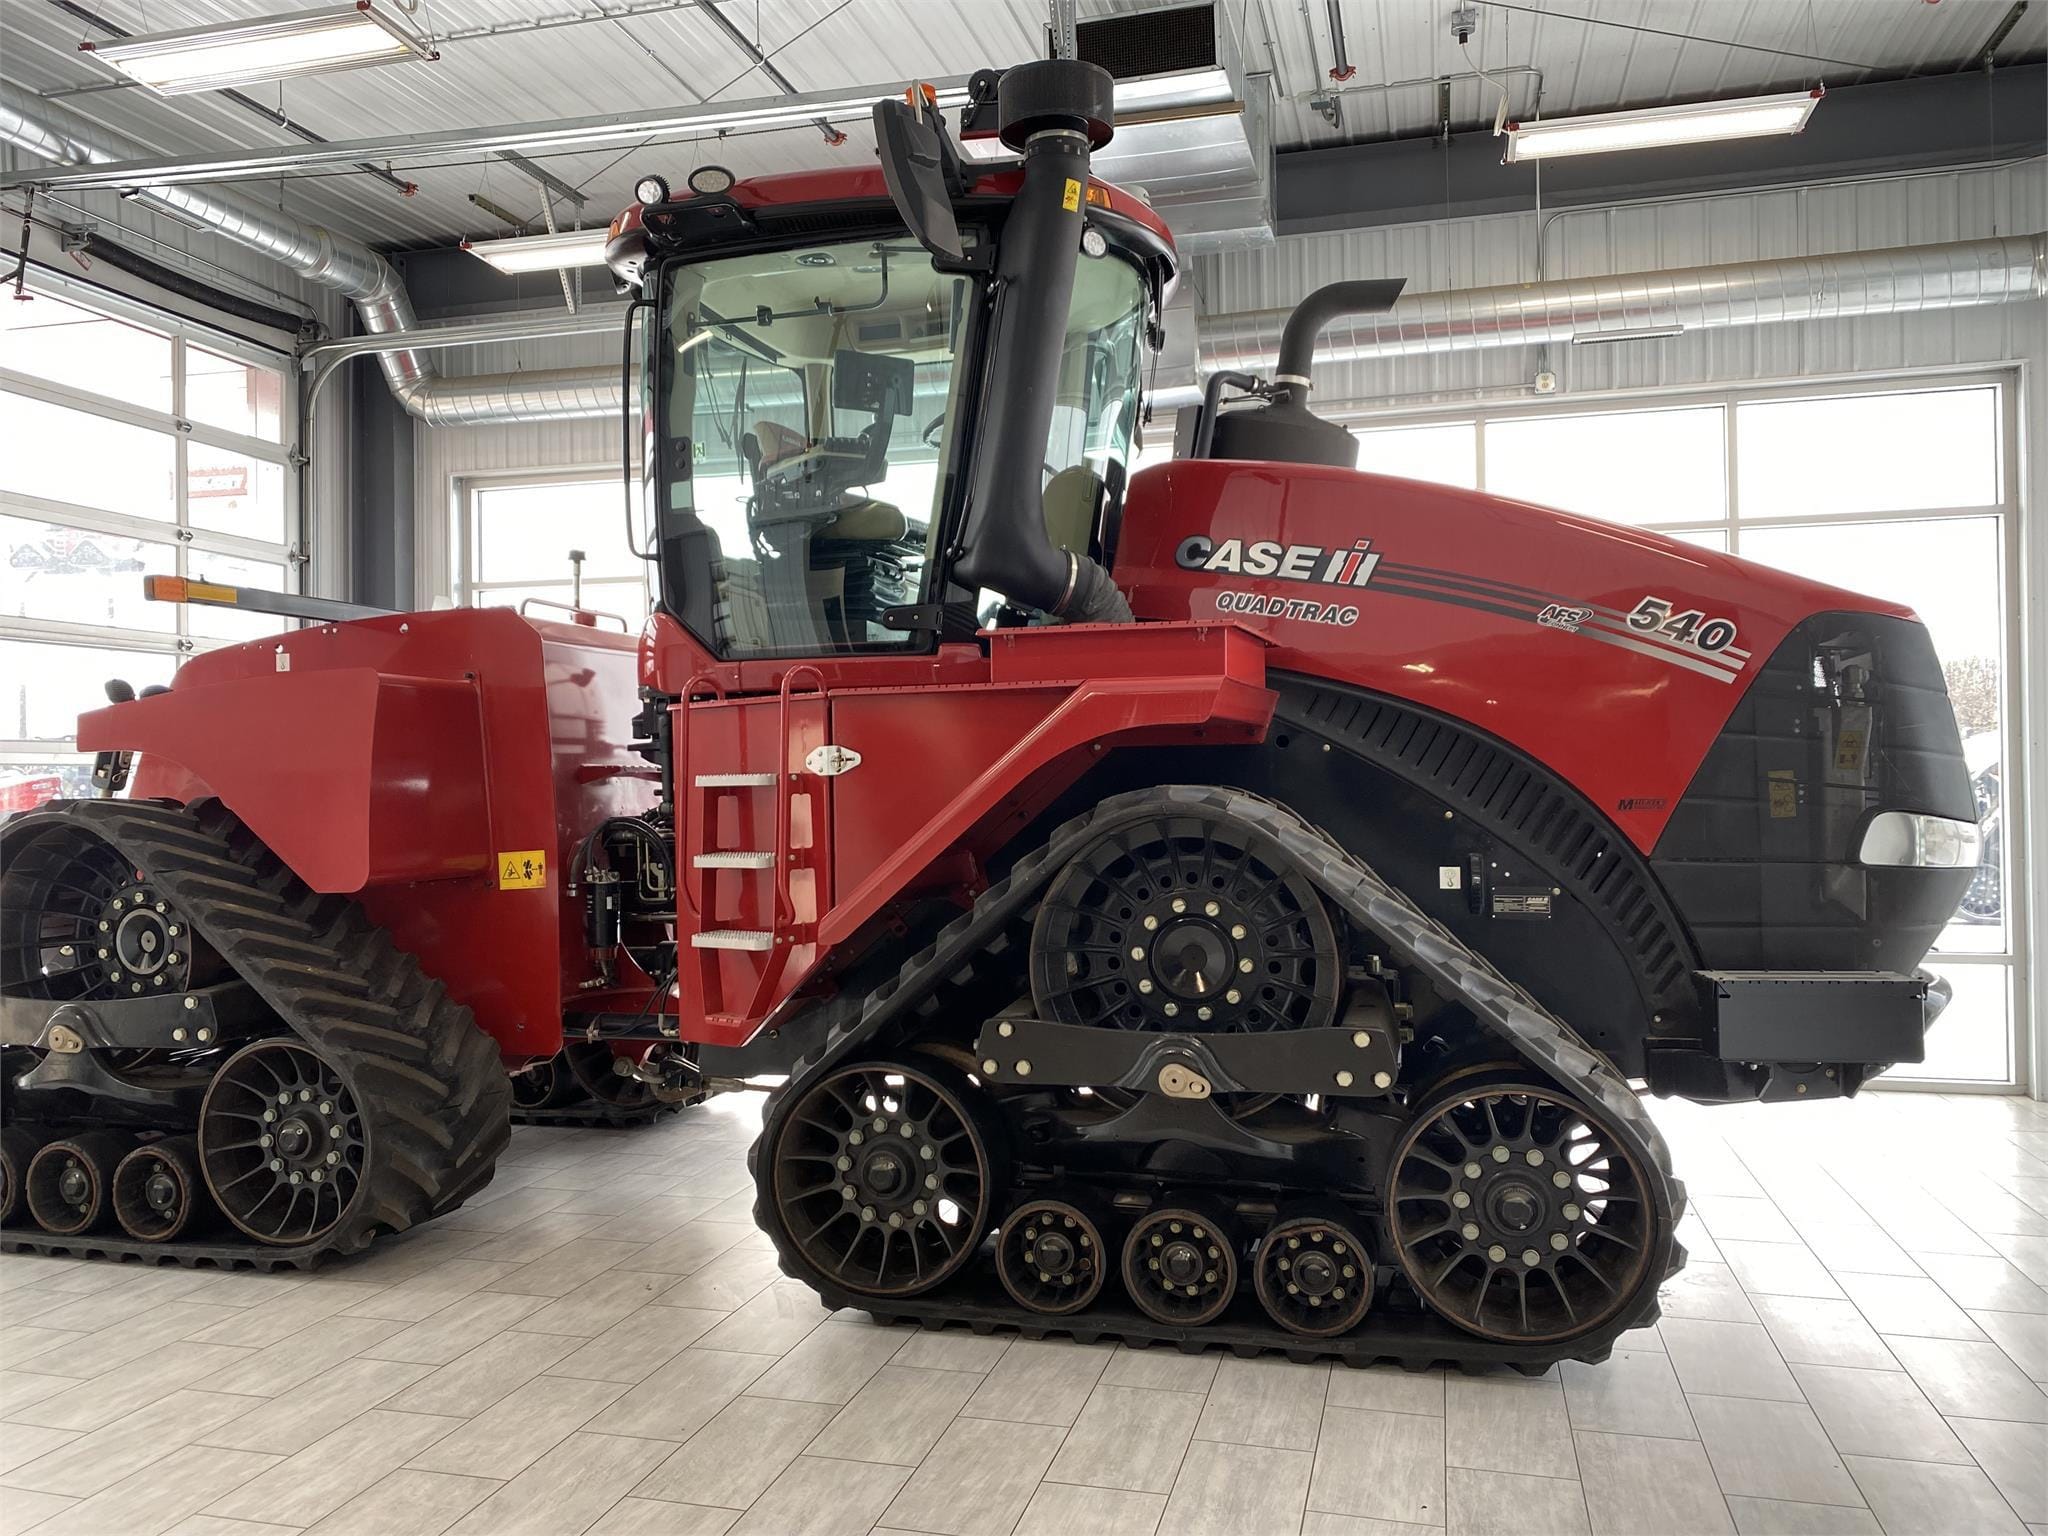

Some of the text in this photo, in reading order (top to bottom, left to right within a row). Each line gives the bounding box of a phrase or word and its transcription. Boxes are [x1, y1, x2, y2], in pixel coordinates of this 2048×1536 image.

[1176, 536, 1322, 580] CASE
[1216, 591, 1359, 625] QUADTRAC
[1538, 604, 1582, 623] AFS
[1626, 596, 1737, 654] 540
